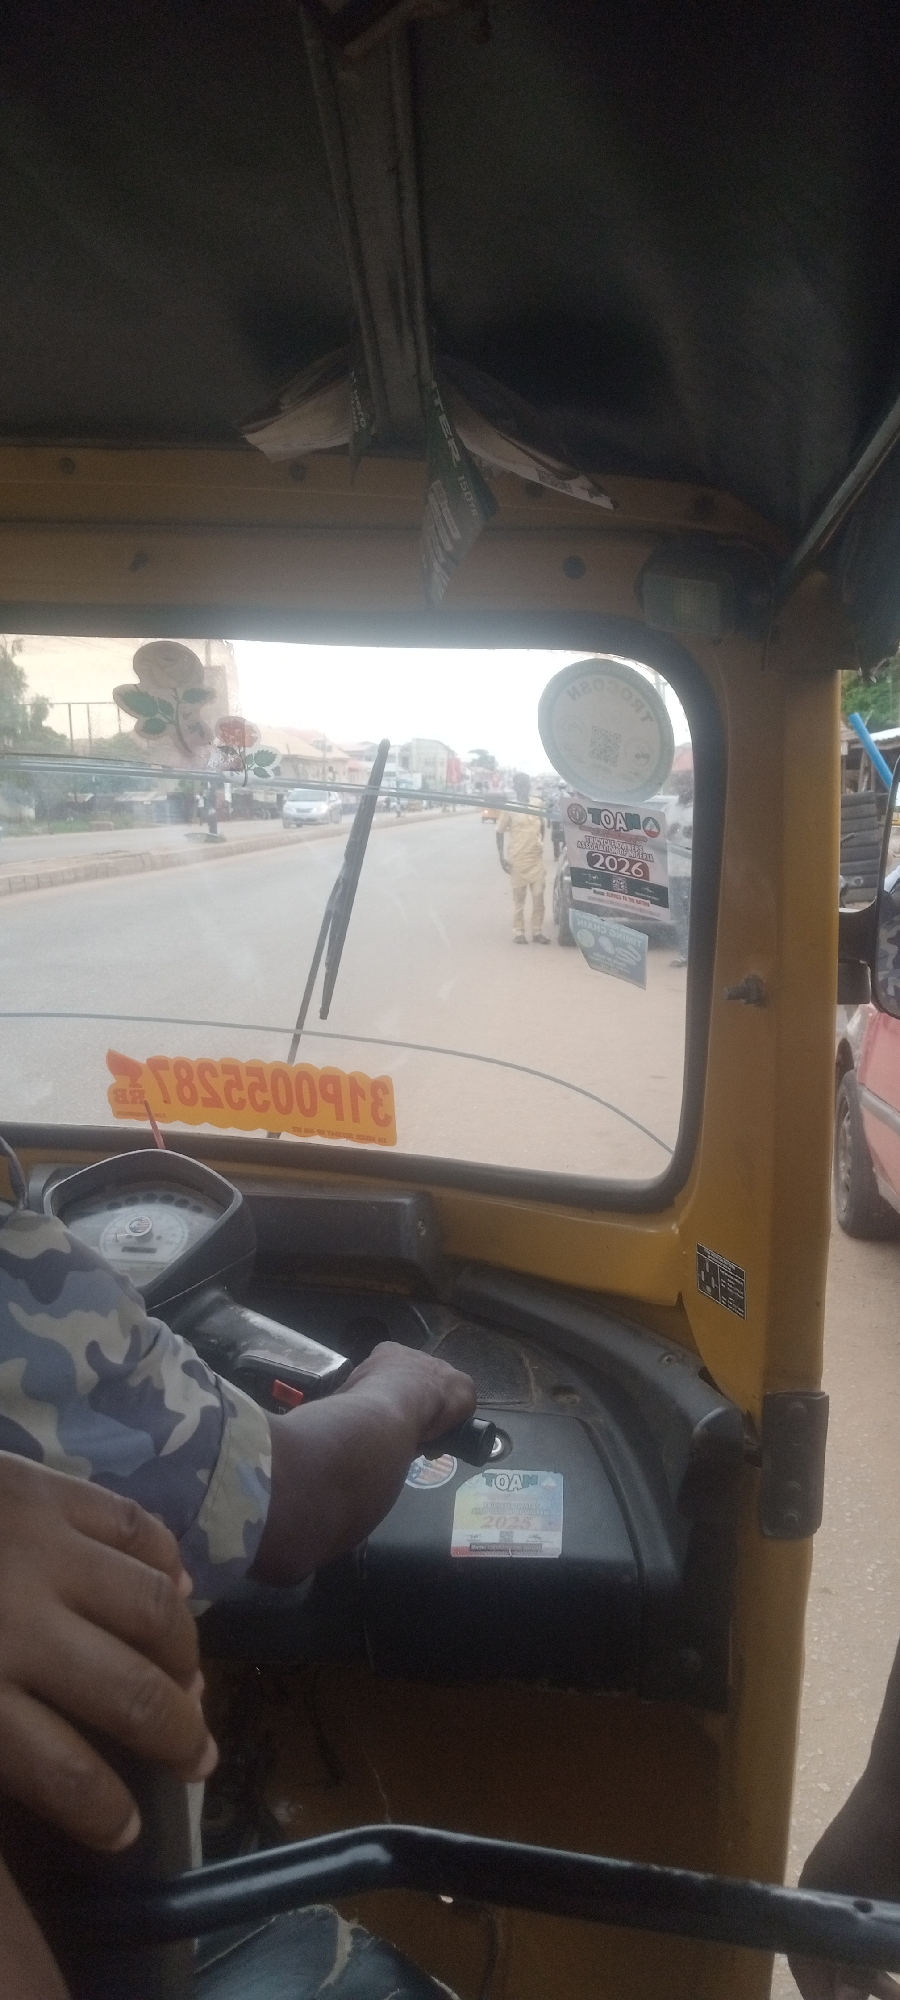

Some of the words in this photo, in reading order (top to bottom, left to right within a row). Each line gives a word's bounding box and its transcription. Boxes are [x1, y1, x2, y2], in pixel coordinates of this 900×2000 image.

[587, 807, 641, 832] TOAN
[591, 852, 644, 877] 2026
[482, 1472, 539, 1492] TOAN
[480, 1515, 533, 1529] 2025
